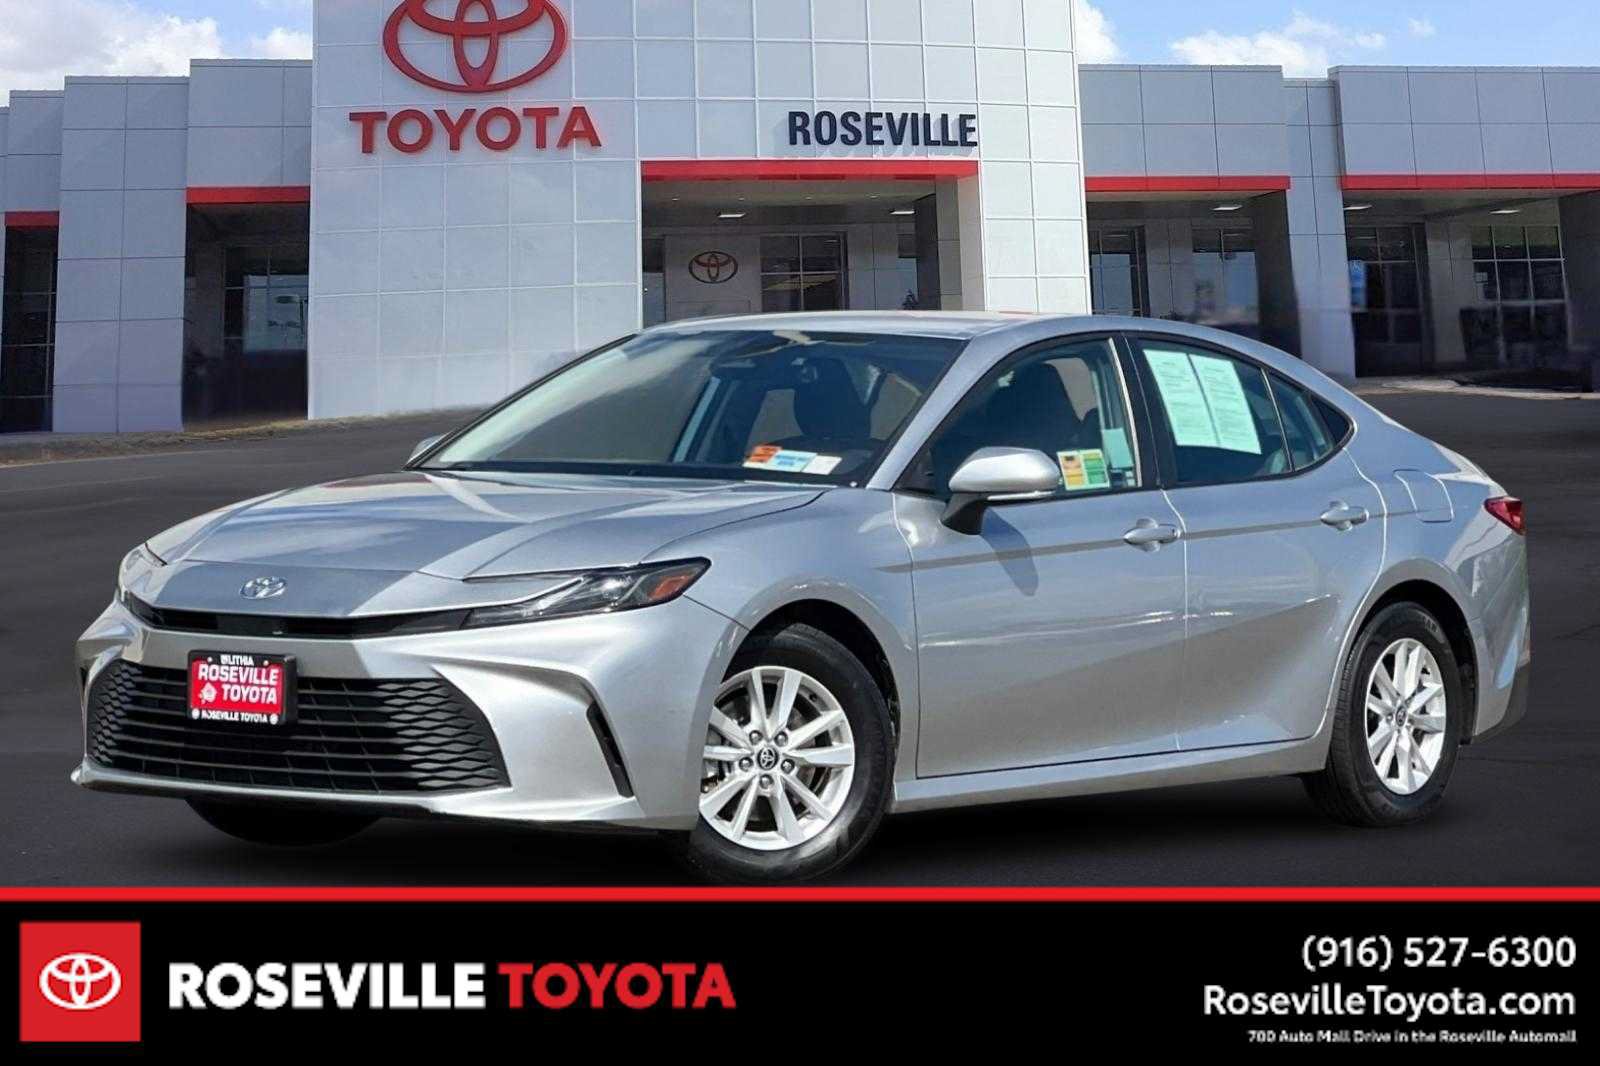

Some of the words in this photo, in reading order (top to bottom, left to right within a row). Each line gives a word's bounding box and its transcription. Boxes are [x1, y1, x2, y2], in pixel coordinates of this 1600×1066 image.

[349, 106, 603, 154] TOYOTA
[788, 110, 978, 147] ROSEVILLE
[198, 663, 279, 686] ROSEVILLE
[221, 683, 277, 705] TOYOTA
[201, 708, 239, 721] ROSEVILLE
[240, 711, 268, 723] TOYOTA
